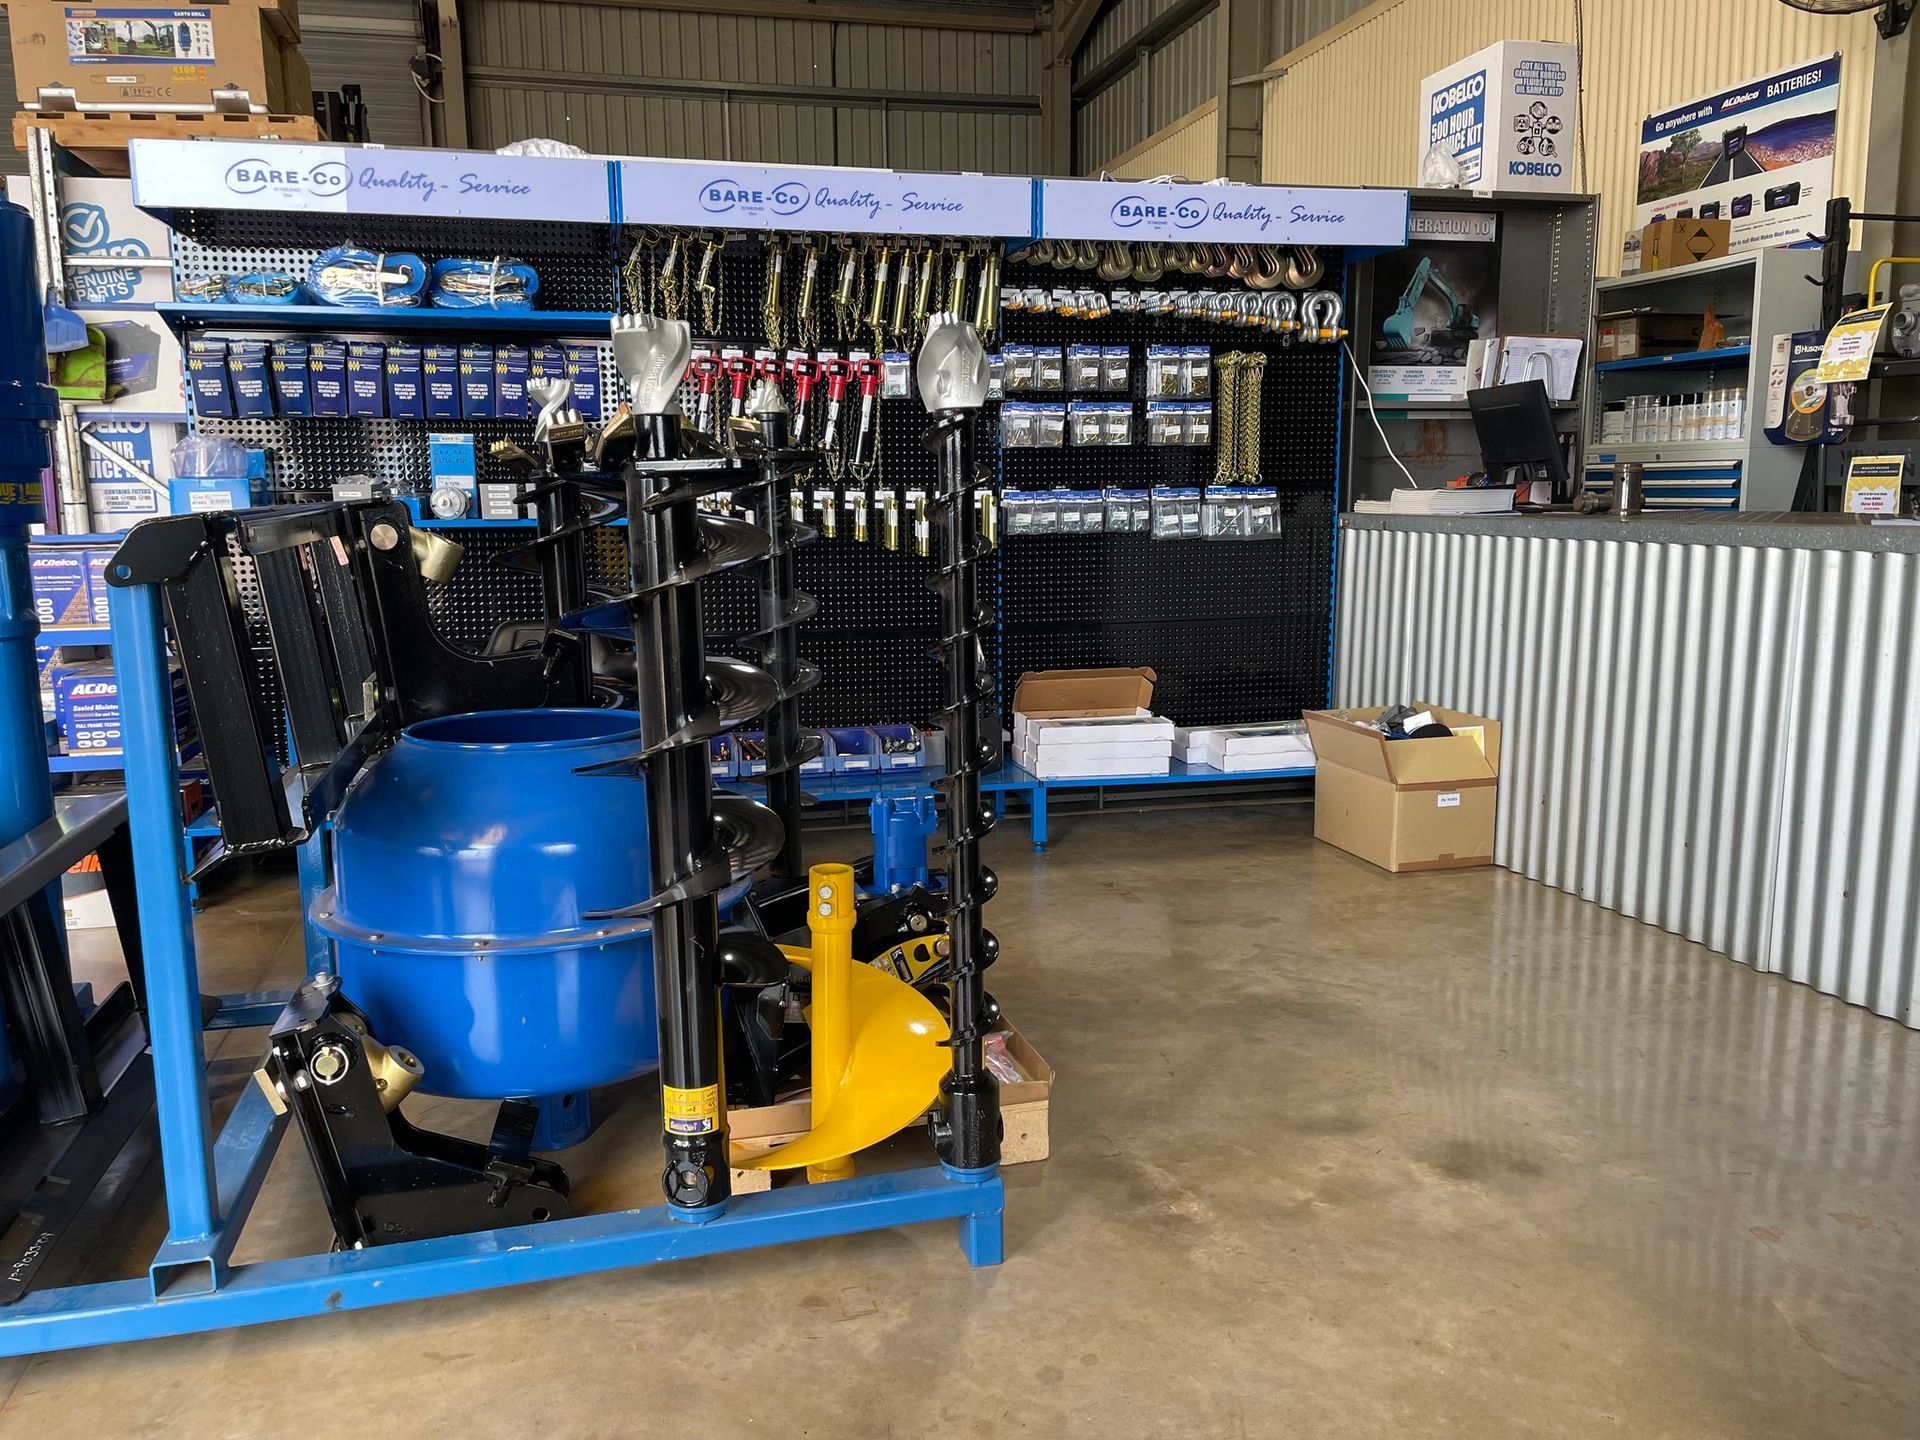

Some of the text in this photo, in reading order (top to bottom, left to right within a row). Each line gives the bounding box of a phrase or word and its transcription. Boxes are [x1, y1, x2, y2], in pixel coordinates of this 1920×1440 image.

[1521, 61, 1533, 70] GOT
[1534, 62, 1543, 70] ALL
[1540, 70, 1566, 81] KOBELCO
[1432, 76, 1485, 116] KOBELCO
[1656, 69, 1822, 132] Go anywhere with ACDelco BATTERIES!
[1432, 107, 1474, 142] 500 HOUR
[1467, 122, 1482, 147] KIT
[1508, 161, 1562, 177] KOBELCO
[358, 168, 437, 201] Quality
[460, 174, 532, 195] Service
[709, 189, 800, 205] BARE-Co
[815, 187, 882, 219] Quality
[902, 192, 964, 211] Service
[1120, 205, 1200, 218] BARE-Co
[1213, 202, 1272, 231] Quality
[1290, 205, 1346, 223] Service
[1474, 220, 1490, 234] 10
[68, 268, 136, 290] GENUINE
[77, 282, 129, 302] PARTS
[32, 559, 78, 567] ACDelco
